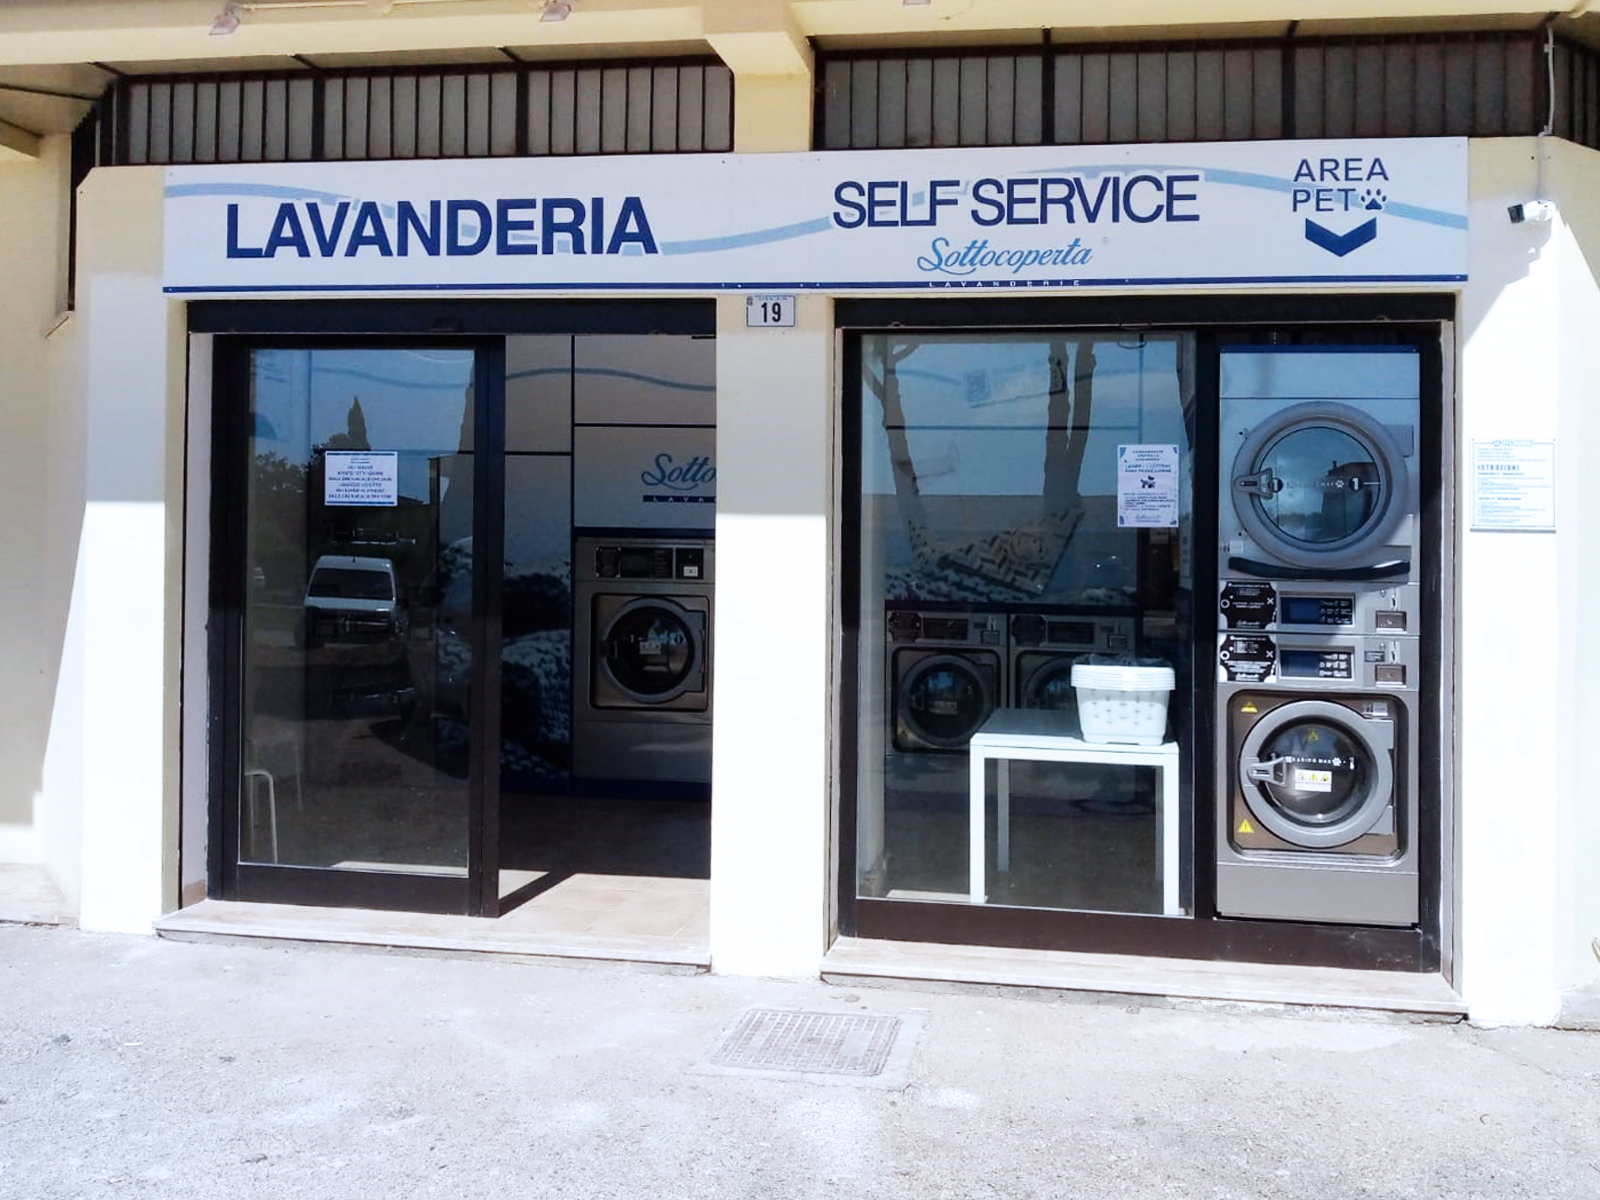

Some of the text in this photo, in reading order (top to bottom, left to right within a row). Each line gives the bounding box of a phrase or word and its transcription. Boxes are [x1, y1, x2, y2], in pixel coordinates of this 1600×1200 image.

[1293, 158, 1389, 182] AREA
[833, 175, 1200, 228] SELF SERVICE
[1292, 188, 1356, 212] PET
[226, 196, 658, 259] LAVANDERIA
[917, 237, 1093, 275] Sottocoperta
[761, 302, 781, 322] 19
[1352, 477, 1359, 491] 1
